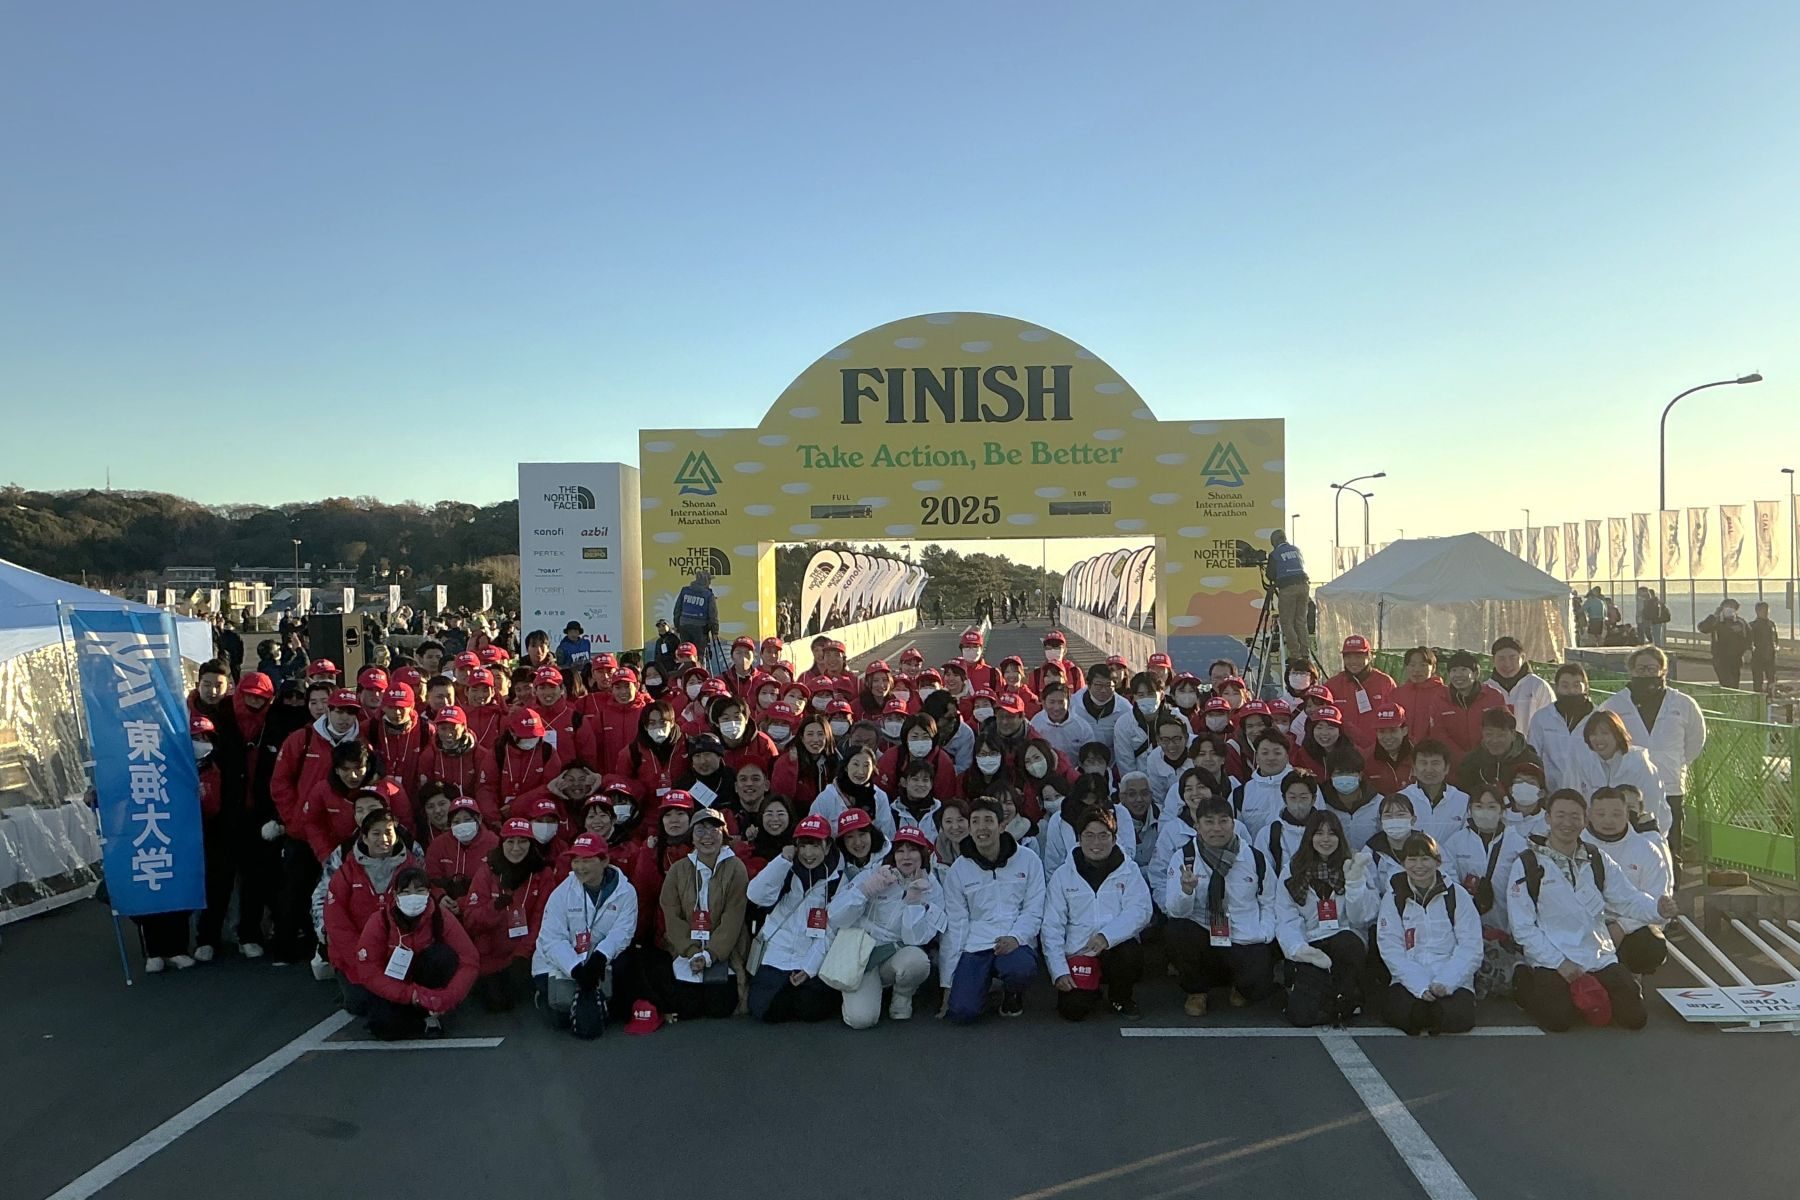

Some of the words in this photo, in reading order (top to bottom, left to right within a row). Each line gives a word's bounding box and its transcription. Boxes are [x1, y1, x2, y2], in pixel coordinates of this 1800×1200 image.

[840, 365, 1073, 424] FINISH
[796, 444, 864, 469] Take
[870, 444, 976, 470] Action,
[983, 442, 1022, 466] Be
[1030, 441, 1124, 465] Better
[559, 485, 577, 494] THE
[543, 493, 578, 502] NORTH
[1207, 491, 1243, 500] Shonan
[553, 501, 578, 510] FACE
[682, 500, 716, 508] Shonan
[1195, 500, 1255, 509] International
[670, 508, 728, 517] International
[921, 496, 1001, 525] 2025
[1203, 509, 1248, 517] Marathon
[678, 517, 721, 525] Marathon
[533, 527, 564, 536] sanofi
[581, 526, 609, 537] azbil
[1212, 539, 1235, 549] THE
[687, 547, 709, 557] THE
[1194, 549, 1235, 559] NORTH
[669, 557, 709, 567] NORTH
[1205, 559, 1236, 569] FACE
[683, 594, 705, 607] PHOTO
